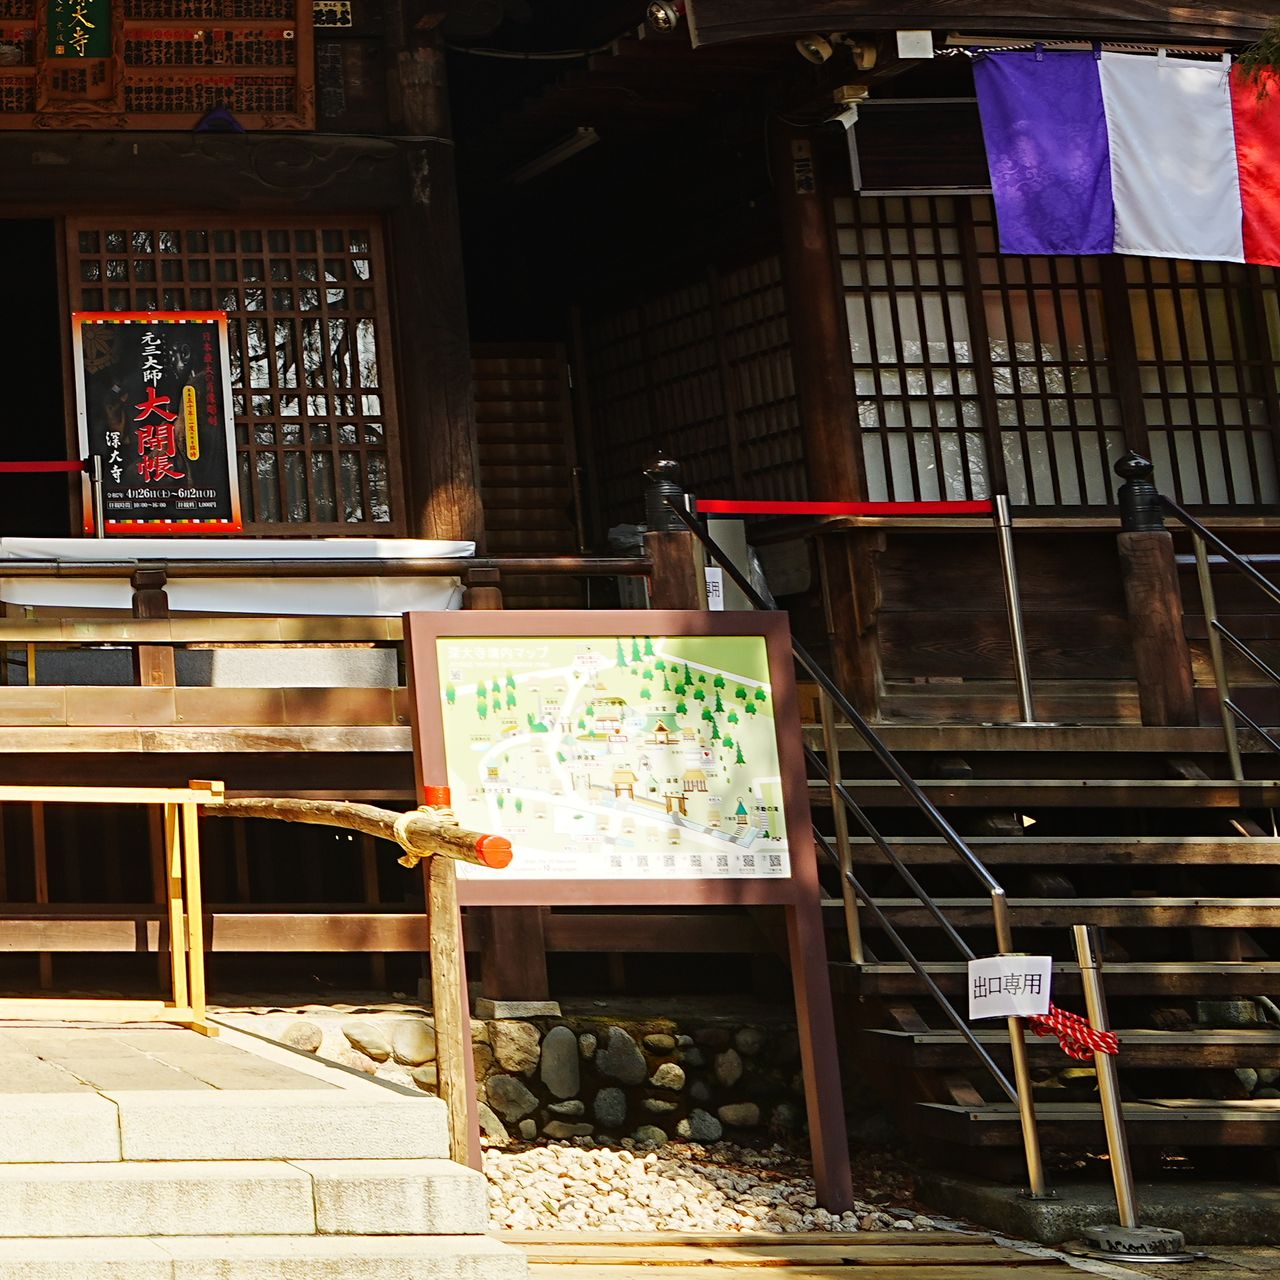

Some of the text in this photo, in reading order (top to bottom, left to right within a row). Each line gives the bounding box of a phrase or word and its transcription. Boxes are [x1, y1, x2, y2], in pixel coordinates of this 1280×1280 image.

[141, 331, 163, 387] 元三大師
[105, 430, 123, 484] 深大寺
[134, 386, 186, 483] 大開帳
[974, 973, 1041, 999] 出口専用
